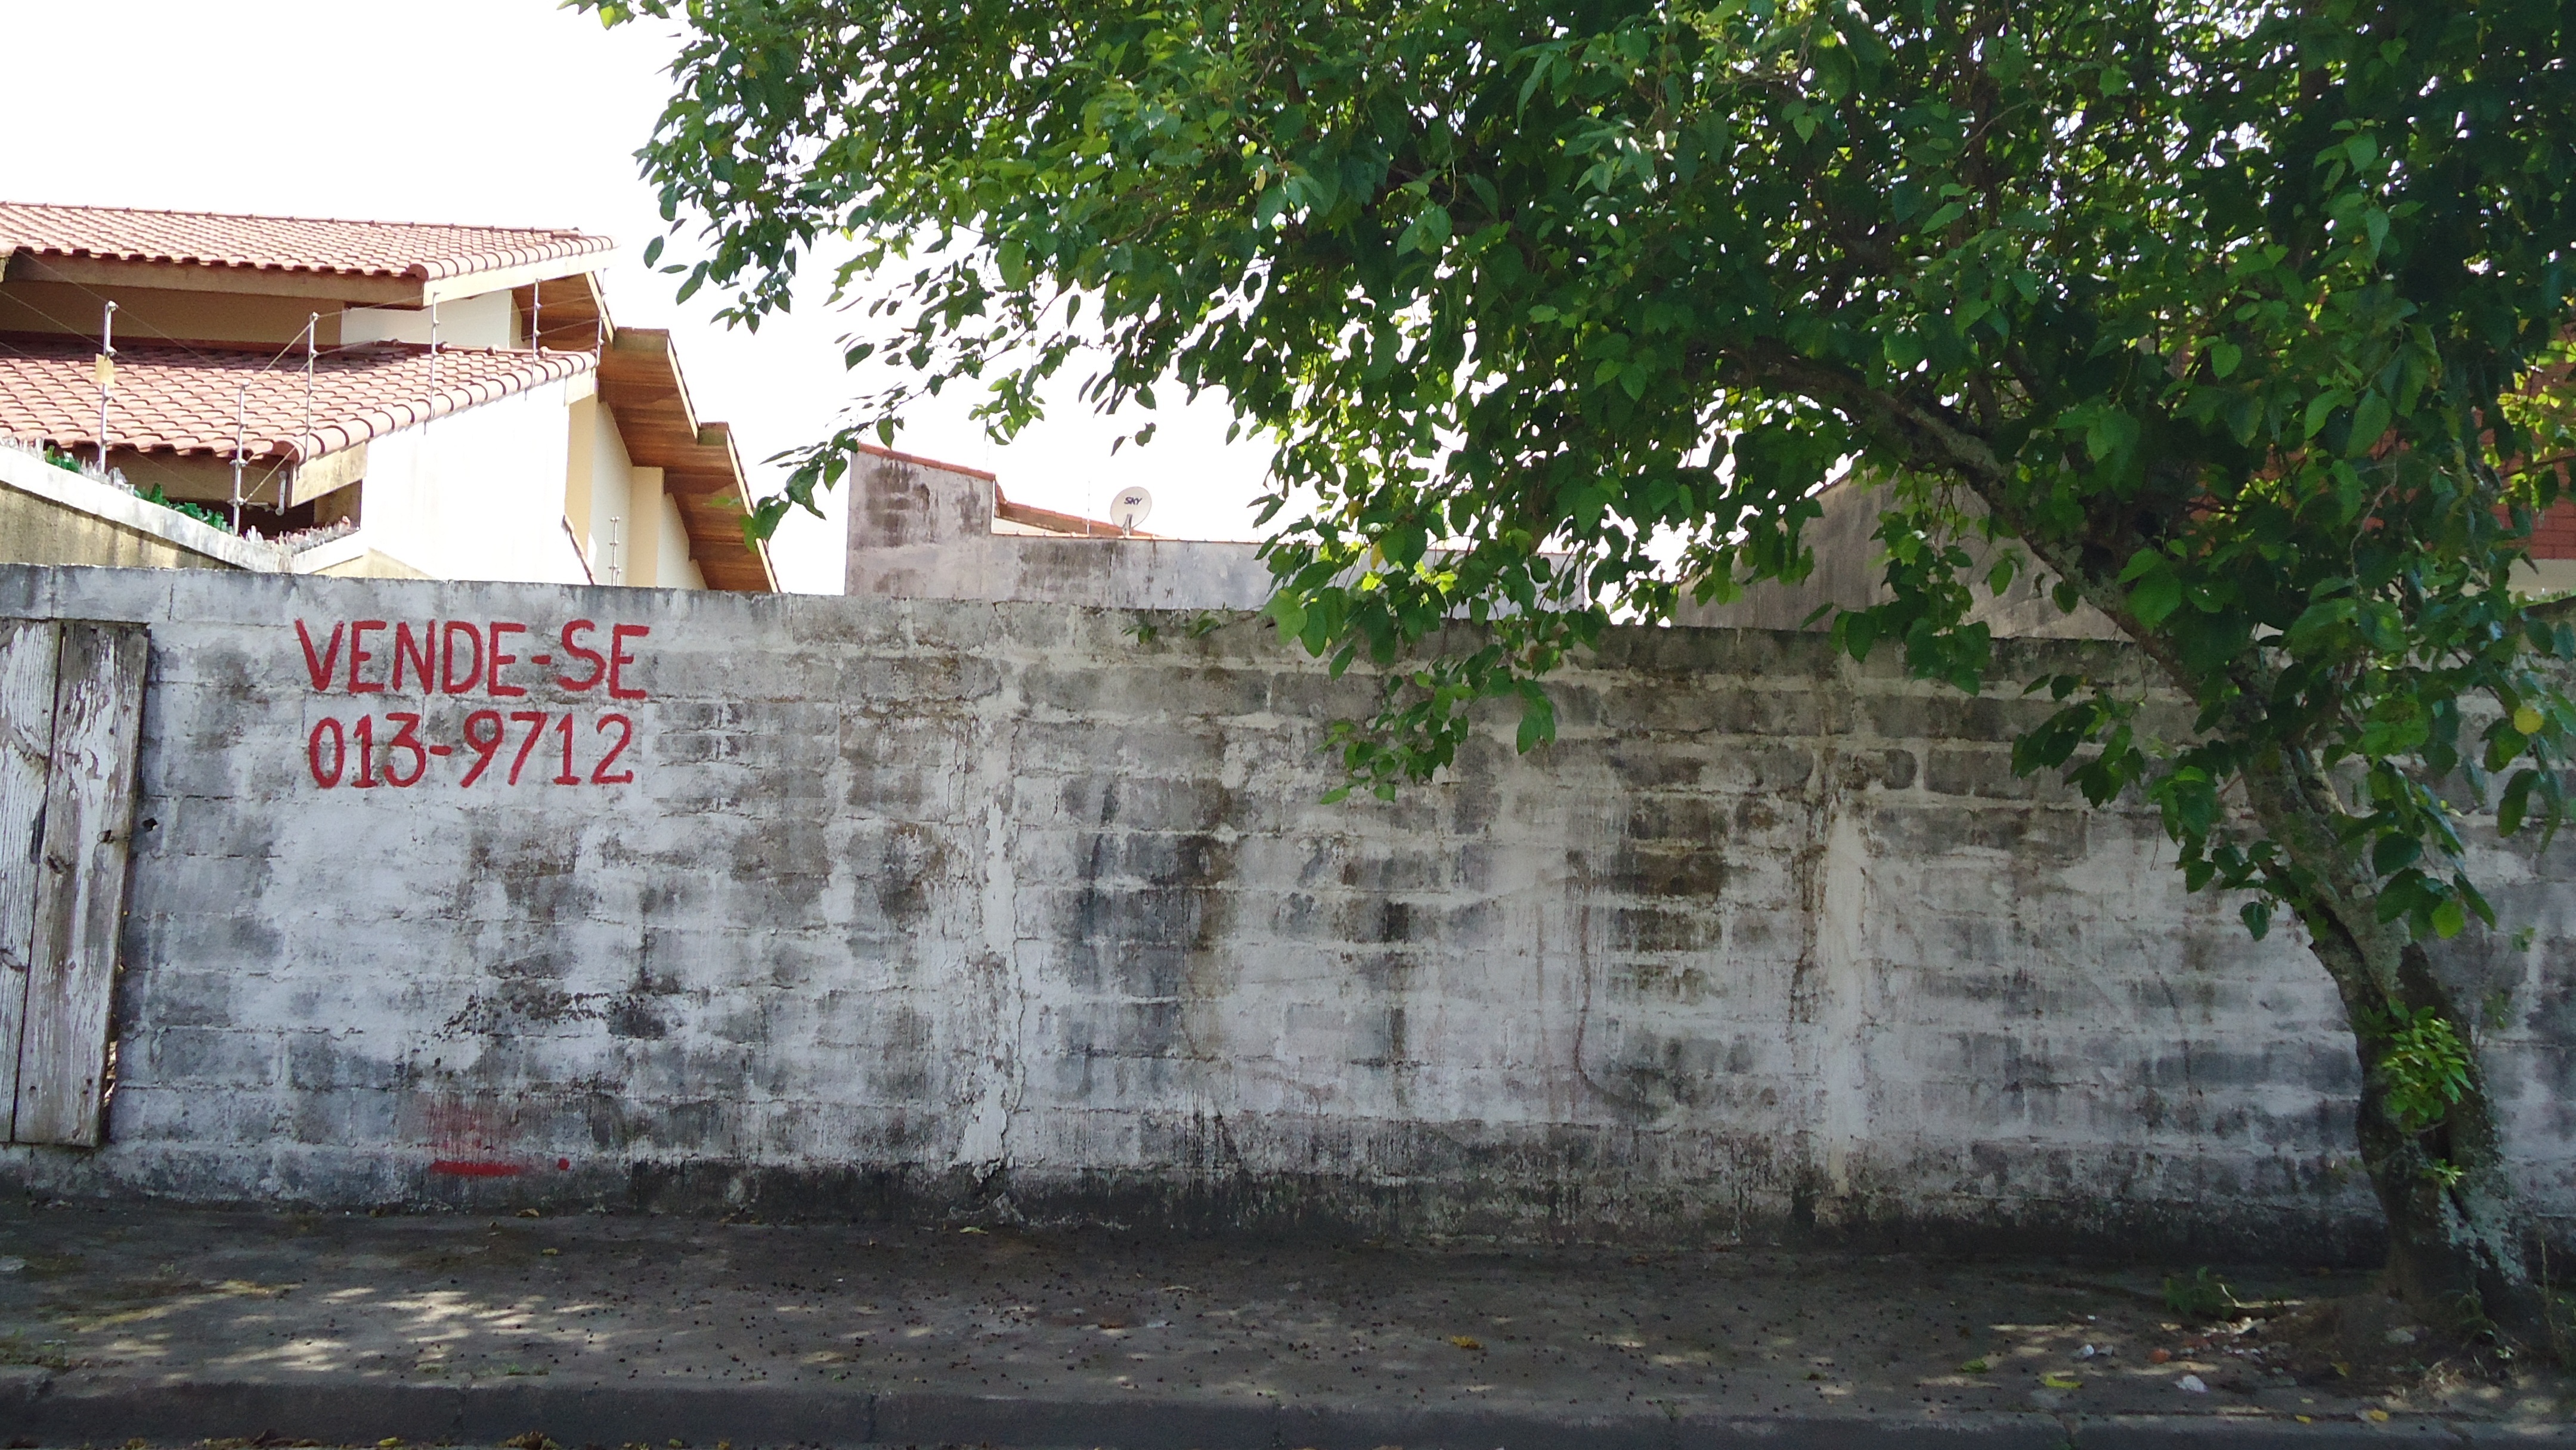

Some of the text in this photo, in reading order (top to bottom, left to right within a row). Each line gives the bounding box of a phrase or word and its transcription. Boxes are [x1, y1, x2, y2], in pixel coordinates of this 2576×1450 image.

[1124, 497, 1143, 505] SKY
[295, 619, 651, 700] VENDE-SE
[308, 709, 634, 789] 013-9712
